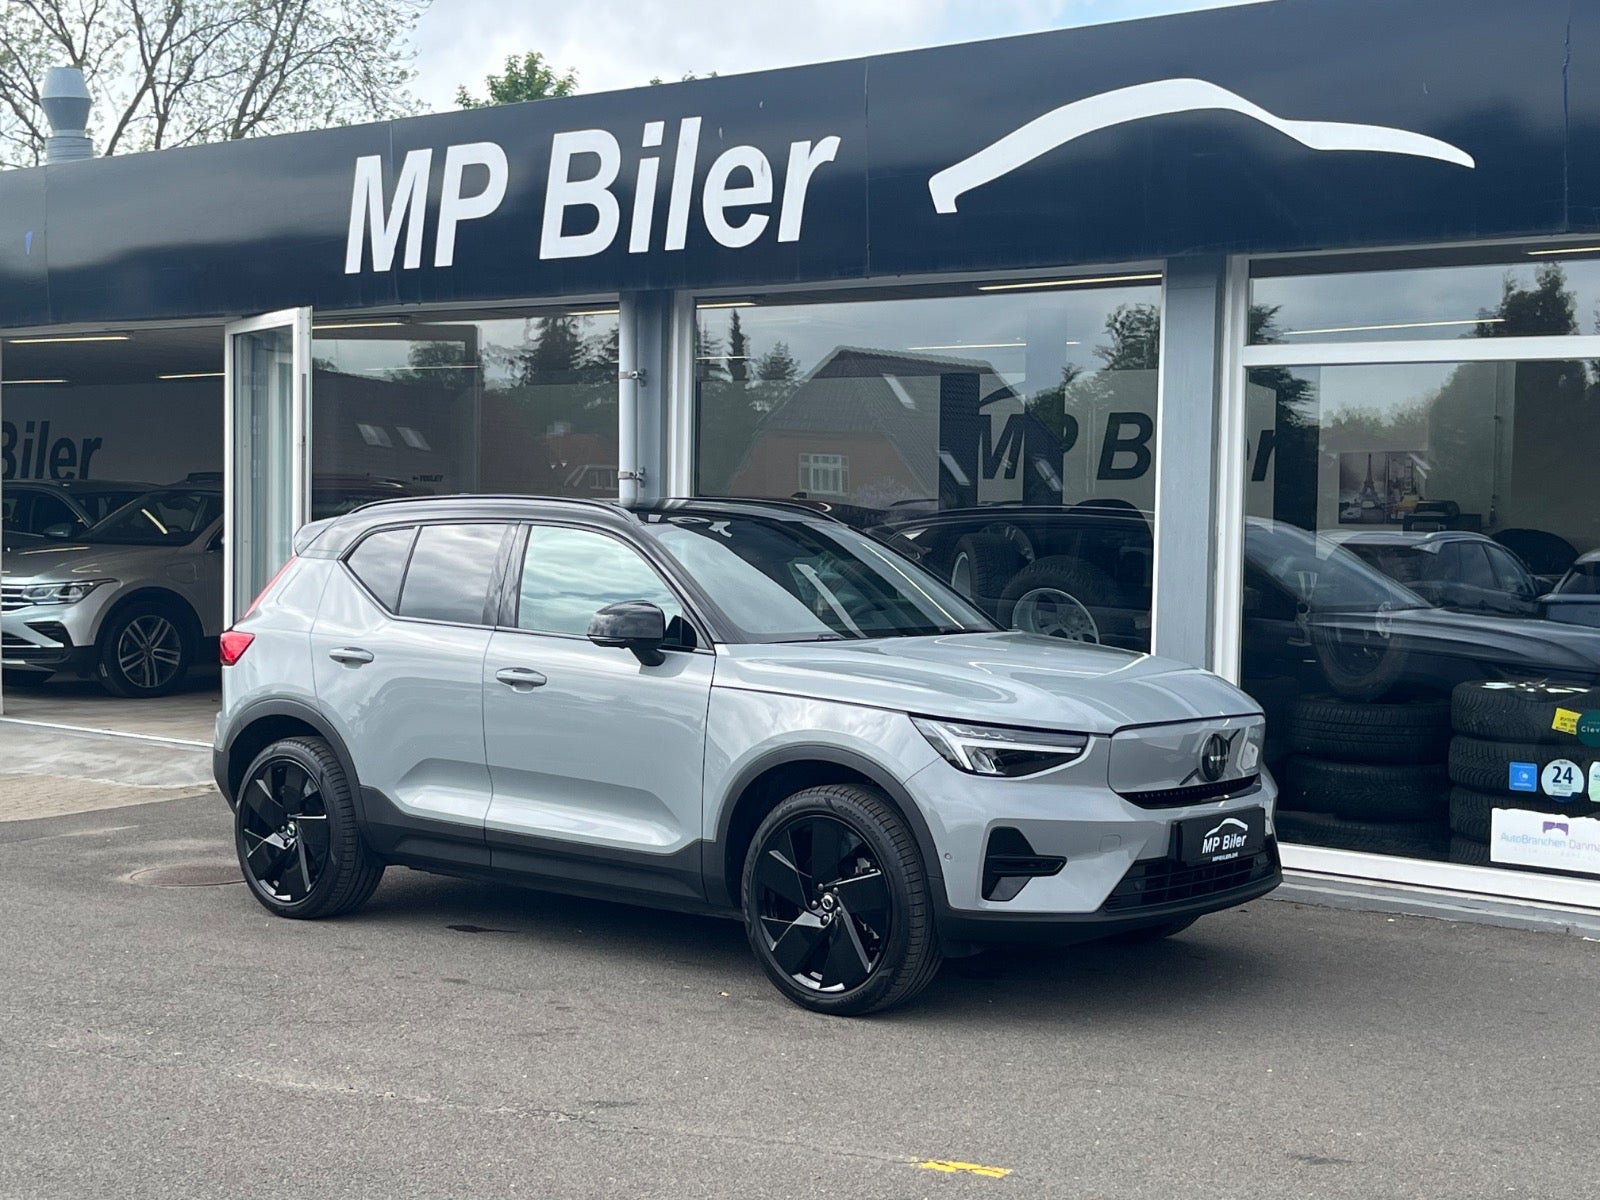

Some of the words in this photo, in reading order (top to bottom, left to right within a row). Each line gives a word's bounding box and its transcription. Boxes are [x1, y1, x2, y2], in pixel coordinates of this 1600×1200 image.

[344, 141, 510, 275] MP
[538, 116, 841, 260] Biler
[1552, 765, 1574, 785] 24
[1202, 836, 1220, 854] MP
[1222, 833, 1247, 850] Biler
[1500, 832, 1566, 848] AutoBranchen
